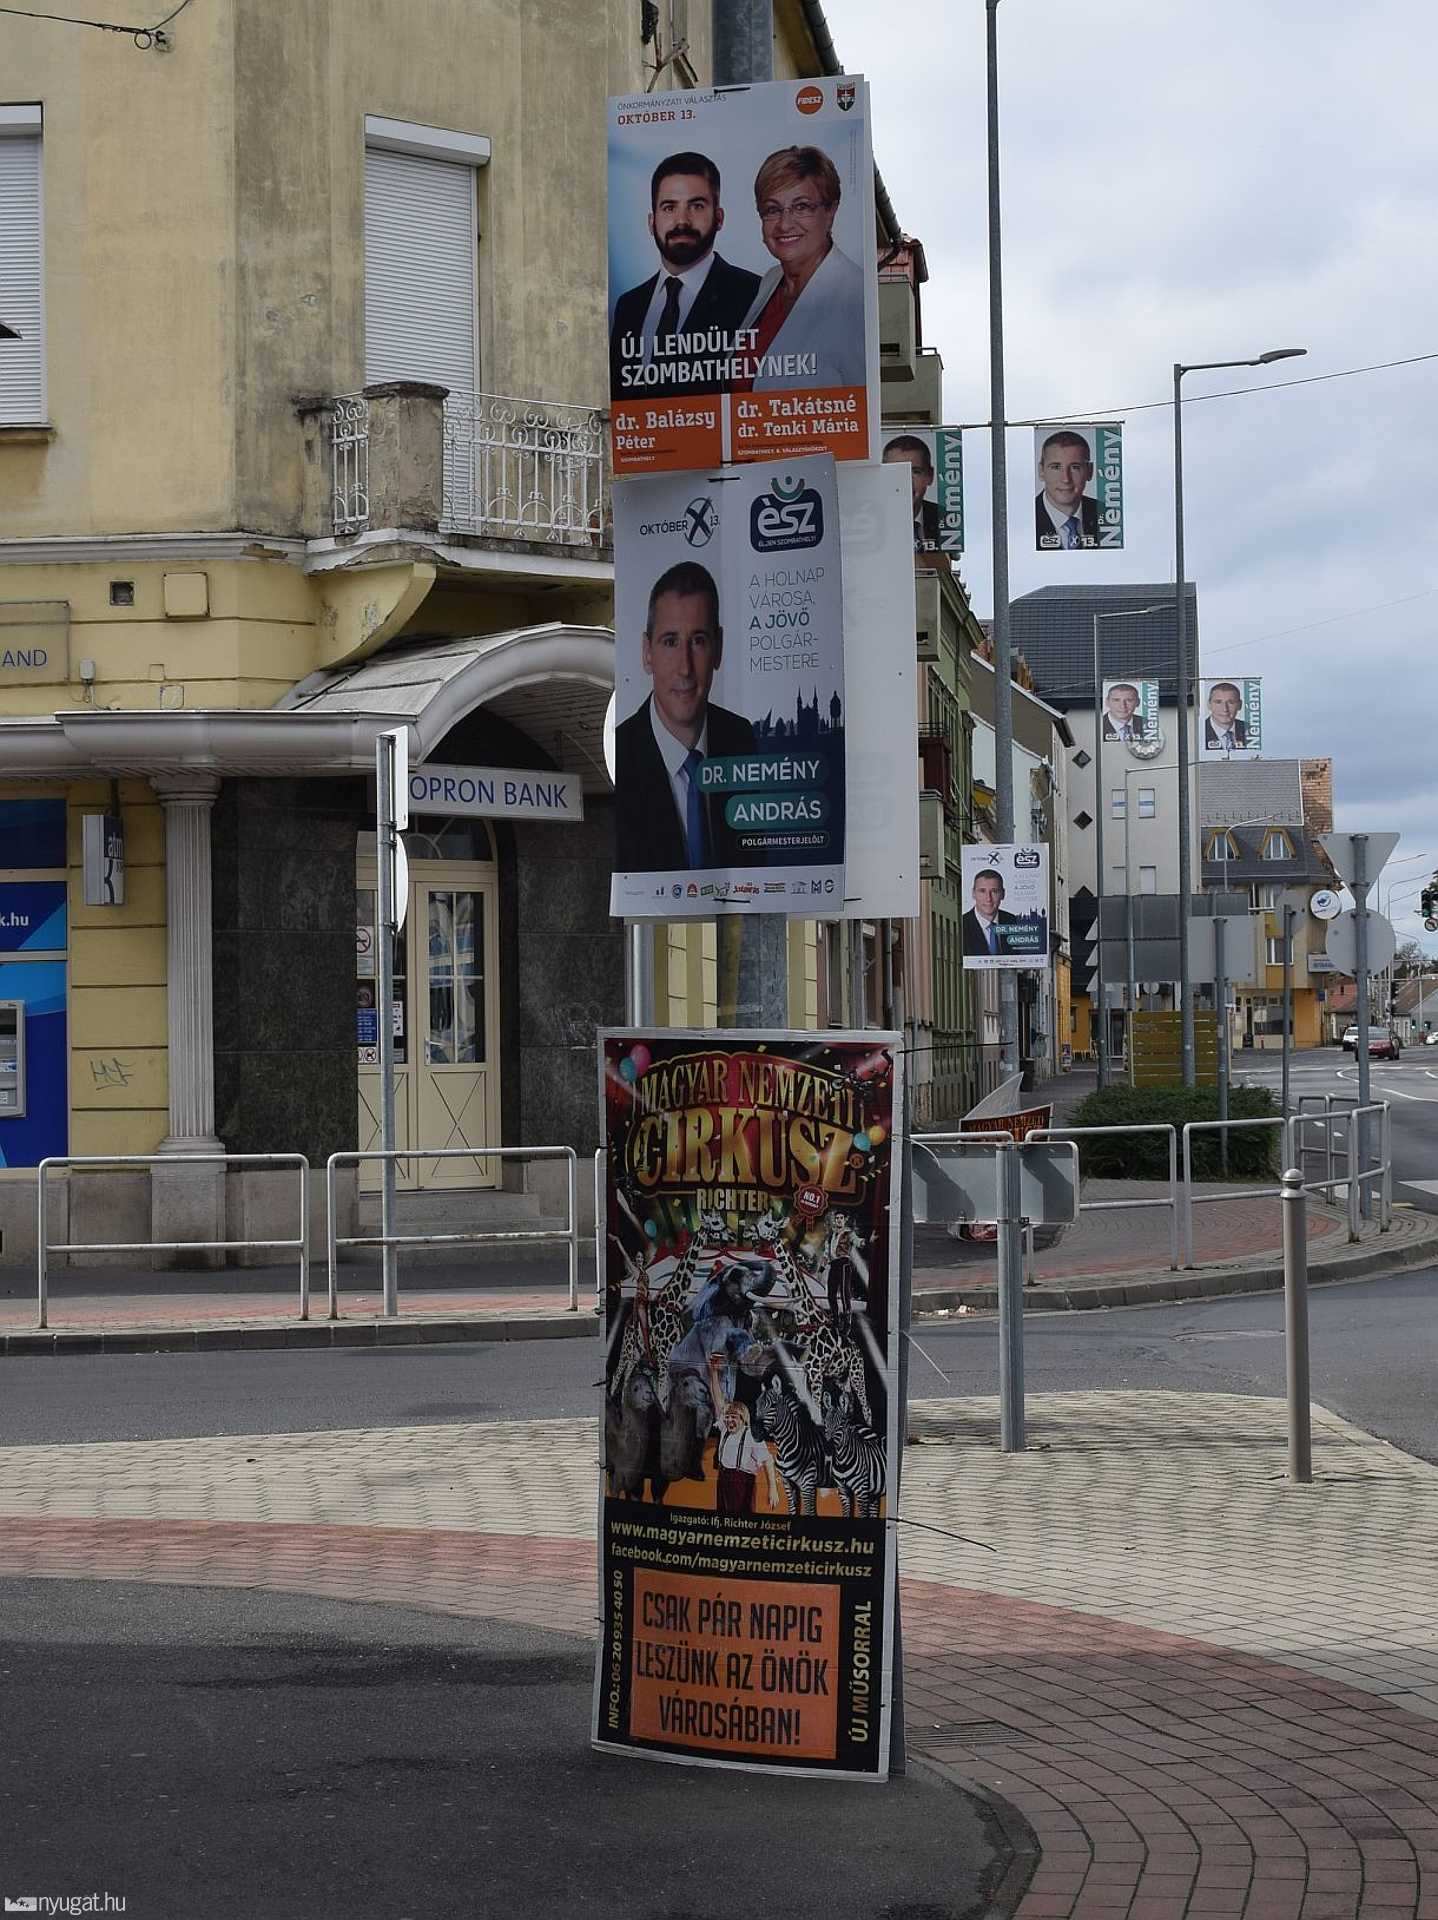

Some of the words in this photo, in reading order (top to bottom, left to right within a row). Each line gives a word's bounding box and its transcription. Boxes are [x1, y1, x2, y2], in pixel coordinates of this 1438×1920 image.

[617, 110, 676, 126] OKTÓBER
[680, 109, 697, 121] 13.
[621, 331, 645, 359] ÚJ
[653, 326, 760, 357] LENDÜLET
[621, 352, 817, 388] SZOMBATHELYNEK!
[615, 413, 640, 431] dr.
[645, 408, 716, 430] Balázsy
[737, 401, 763, 419] dr.
[769, 393, 857, 417] Takátsné
[615, 434, 656, 450] Péter
[738, 423, 759, 438] dr.
[763, 419, 808, 437] Tenki
[812, 417, 860, 434] Mária
[938, 432, 962, 551] Nemény
[1098, 430, 1122, 548] Nemény
[639, 518, 689, 537] OKTÓBER
[709, 515, 721, 528] 13.
[749, 574, 761, 589] A
[764, 566, 825, 587] HOLNAP
[749, 615, 762, 630] A
[765, 607, 810, 629] JÖVŐ
[750, 631, 819, 651] POLGÁR-
[750, 653, 820, 673] MESTERE
[1144, 679, 1159, 742] Nemény
[1245, 677, 1261, 750] Nemény
[702, 766, 727, 785] DR.
[732, 757, 820, 783] NEMÉNY
[409, 774, 495, 804] OPRON
[504, 783, 568, 808] BANK
[734, 796, 822, 822] ANDRÁS
[639, 1059, 728, 1116] MAGYAR
[738, 1059, 855, 1129] NEMZETI
[634, 1106, 857, 1194] CIRKUSZ
[696, 1188, 769, 1211] RICHTER
[670, 1512, 710, 1526] Igazgató:
[724, 1517, 758, 1529] Richter
[760, 1520, 792, 1531] József
[610, 1520, 875, 1555] www.magyarnemzeticirkusz.hu
[611, 1542, 873, 1578] facebook.com/magyarnemzeticirkusz
[642, 1590, 692, 1634] CSAK
[698, 1592, 742, 1638] PÁR
[749, 1603, 823, 1644] NAPIG
[636, 1640, 720, 1689] LESZÜNK
[726, 1653, 754, 1691] AZ
[760, 1648, 829, 1696] ÖNÖK
[849, 1600, 872, 1714] MŰSORRAL
[659, 1690, 801, 1745] VÁROSÁBAN!
[848, 1718, 869, 1742] ÚJ
